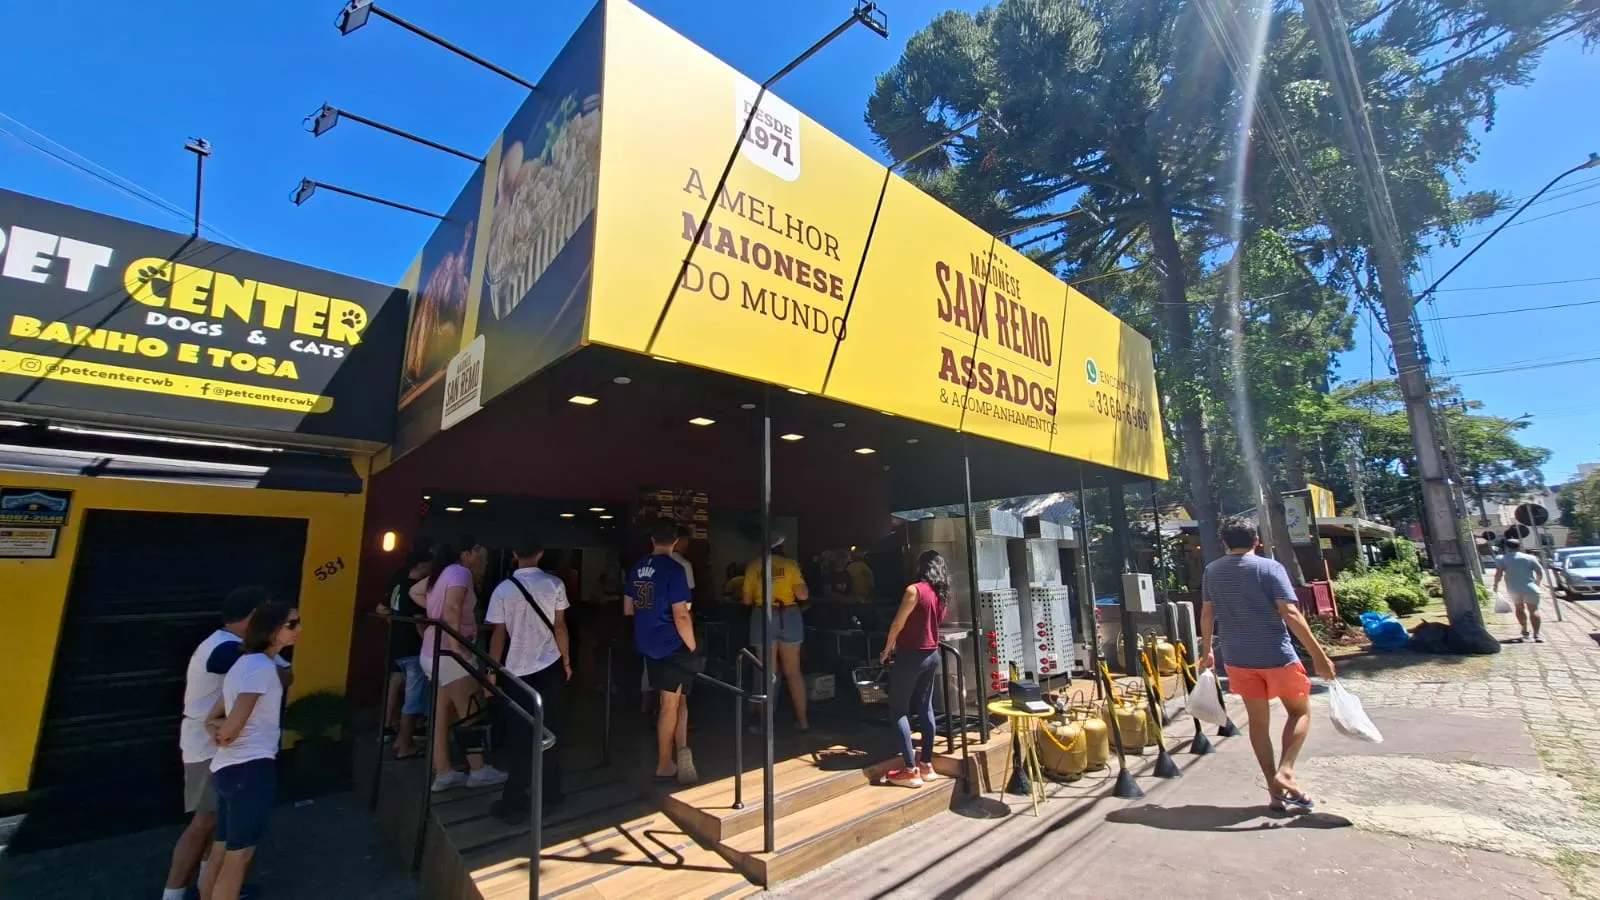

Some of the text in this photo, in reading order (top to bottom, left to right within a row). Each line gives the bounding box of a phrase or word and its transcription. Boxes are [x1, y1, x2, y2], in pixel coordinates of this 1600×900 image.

[743, 100, 793, 140] DESDE
[743, 118, 794, 166] 1971
[682, 167, 841, 262] A MELHOR
[681, 210, 844, 301] MAIONESE
[970, 252, 1021, 300] MAIONESE
[0, 225, 368, 347] ET CENTER
[681, 259, 847, 342] DO MUNDO
[145, 311, 345, 359] DOGS & CATS
[935, 260, 1052, 367] SAN REMO
[9, 314, 299, 380] BANHO E TOSA
[45, 362, 174, 388] @petcentercwb
[212, 386, 314, 408] @petcentercwb
[938, 346, 1057, 416] ASSADOS
[939, 388, 949, 403] &
[951, 391, 1058, 435] ACOMPANHAMENTOS
[314, 556, 345, 581] 581
